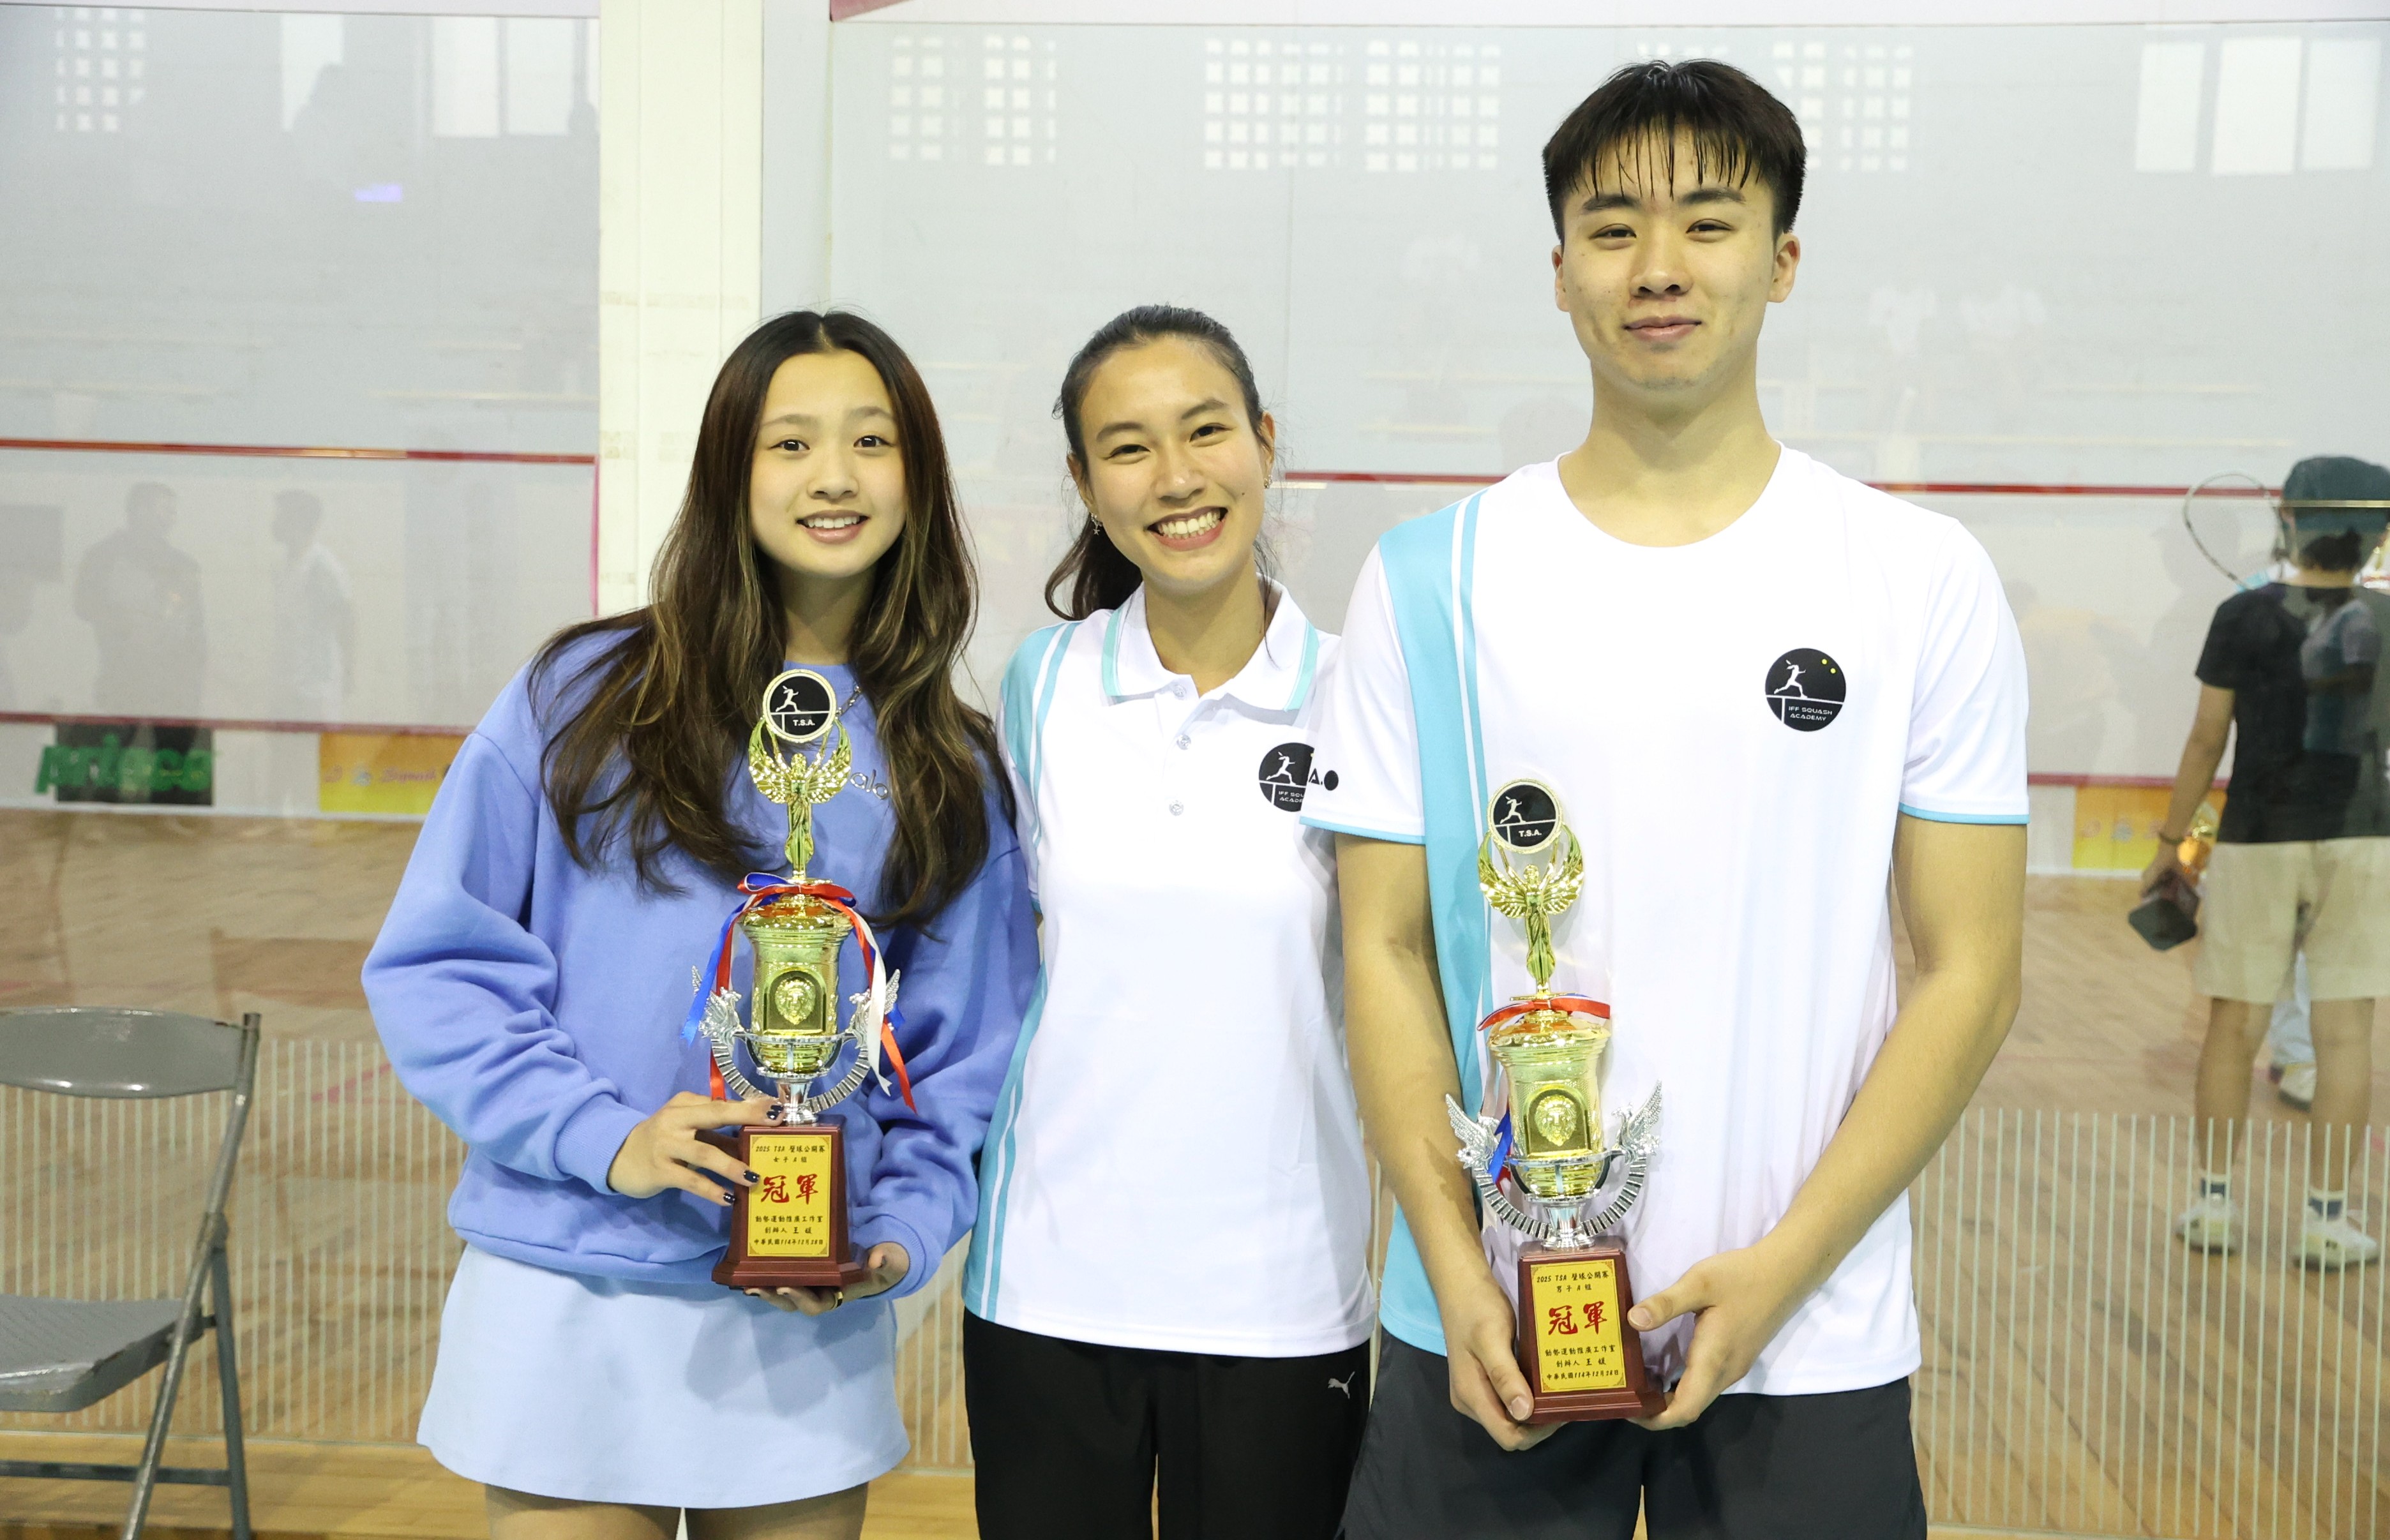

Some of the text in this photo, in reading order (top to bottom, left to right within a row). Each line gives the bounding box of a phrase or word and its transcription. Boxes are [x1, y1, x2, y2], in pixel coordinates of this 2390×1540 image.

[1790, 713, 1827, 721] ACADEMY
[760, 1173, 818, 1204] 冠軍
[1572, 1271, 1609, 1281] 壁球公開賽
[1548, 1301, 1607, 1335] 冠軍
